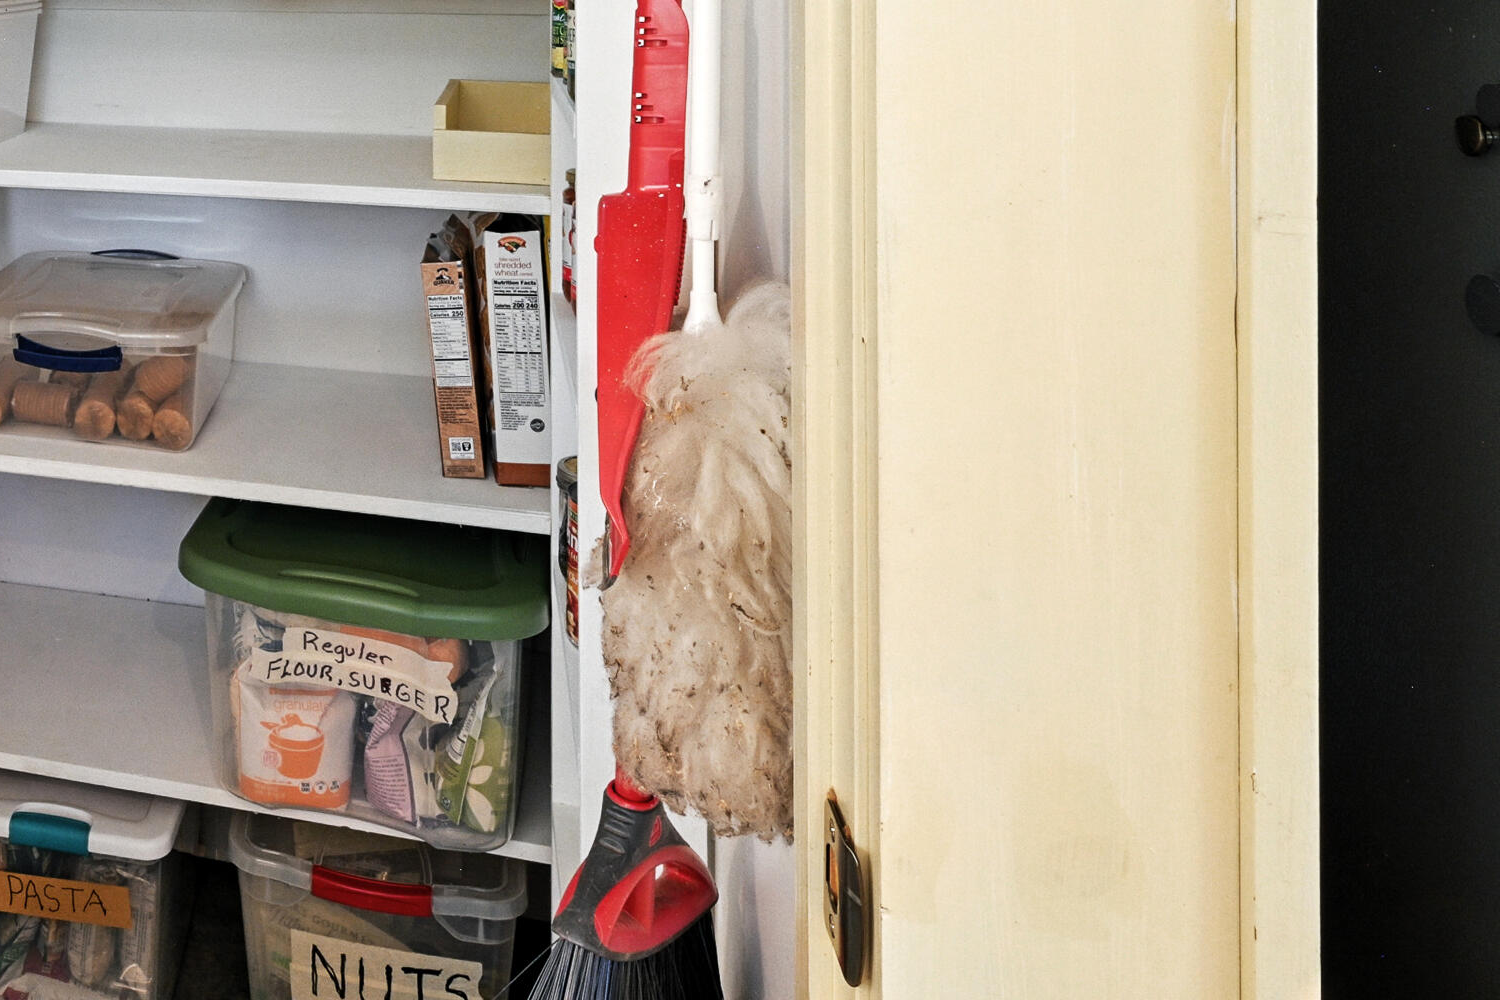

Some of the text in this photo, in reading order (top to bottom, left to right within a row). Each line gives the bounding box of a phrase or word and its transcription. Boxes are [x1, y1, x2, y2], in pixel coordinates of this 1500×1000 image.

[494, 261, 532, 269] shredded
[302, 630, 394, 665] Reguler
[266, 657, 344, 686] FLOUR,
[7, 874, 107, 917] PASTA
[311, 943, 470, 1000] NUTS
